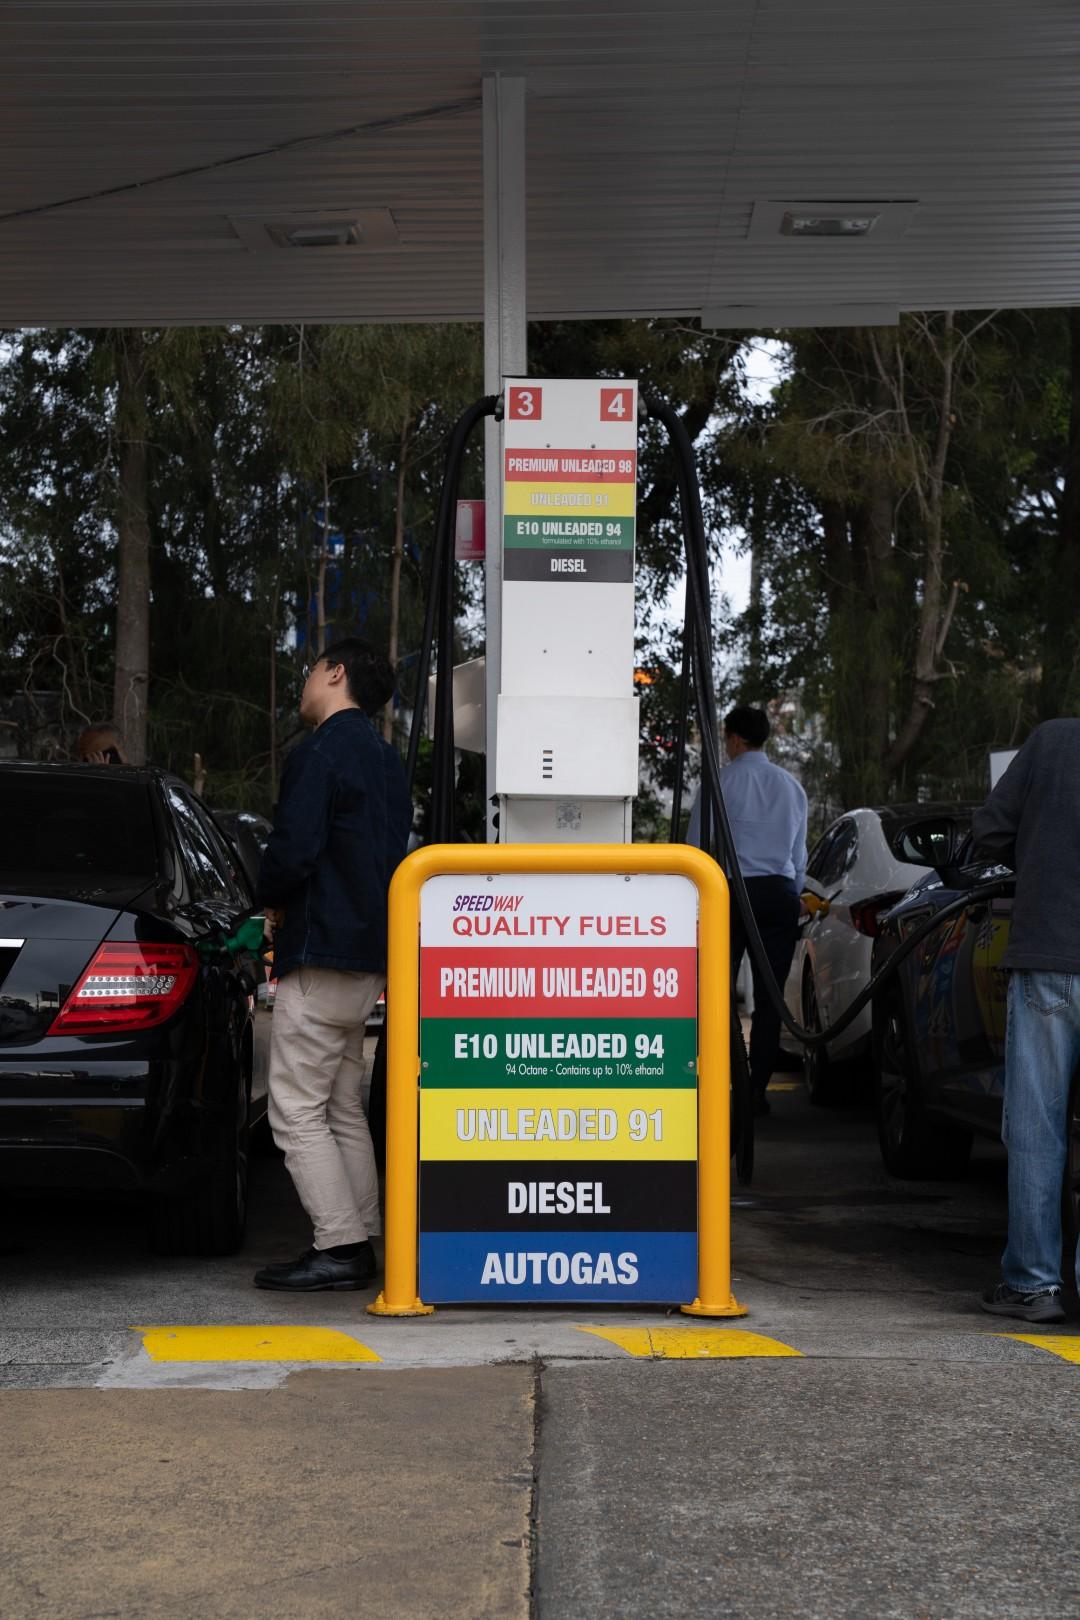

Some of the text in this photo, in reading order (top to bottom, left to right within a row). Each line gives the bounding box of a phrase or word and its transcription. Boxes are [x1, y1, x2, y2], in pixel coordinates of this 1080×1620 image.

[517, 391, 534, 416] 3
[607, 393, 625, 417] 4
[508, 458, 632, 473] PREMIUM UNLEADED 98
[531, 493, 609, 507] UNLEADED 91
[516, 521, 622, 536] E10 UNLEADED 94
[542, 537, 572, 545] formulated
[600, 538, 622, 546] ethanol
[550, 558, 587, 573] DIESEL
[452, 895, 524, 912] SPEEDWAY
[452, 916, 667, 937] QUALITY FUELS
[440, 967, 679, 998] PREMIUM UNLEADED 98
[454, 1033, 665, 1059] E10 UNLEADED 94
[505, 1064, 517, 1075] 94
[518, 1064, 548, 1075] Octane
[555, 1064, 591, 1075] Contains
[592, 1067, 602, 1078] up
[604, 1065, 613, 1075] to
[615, 1064, 633, 1075] 10%
[634, 1063, 664, 1075] ethanol
[456, 1108, 663, 1142] UNLEADED 91
[508, 1181, 611, 1215] DIESEL
[480, 1251, 639, 1286] AUTOGAS
